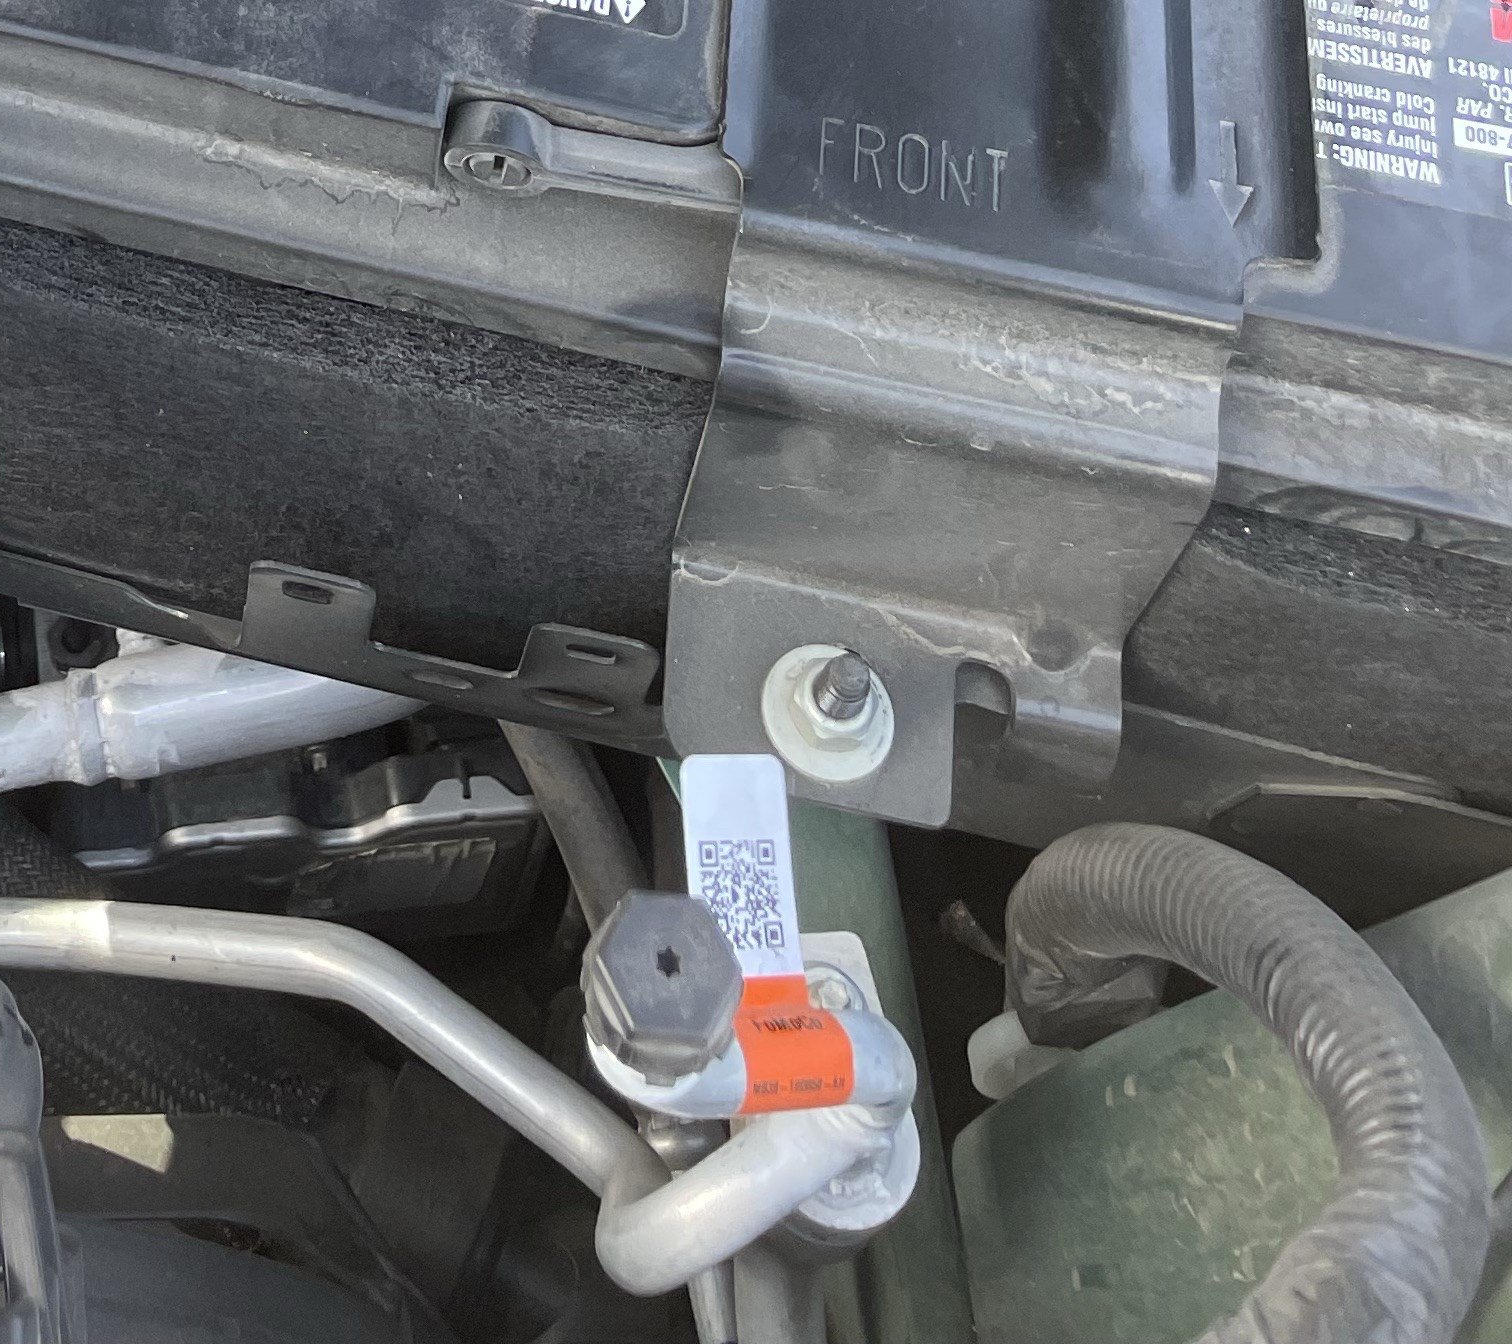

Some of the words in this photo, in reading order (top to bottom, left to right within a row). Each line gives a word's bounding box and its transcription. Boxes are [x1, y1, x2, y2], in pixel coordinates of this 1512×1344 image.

[1400, 33, 1431, 55] des
[1447, 56, 1499, 81] 48121
[1315, 72, 1391, 103] cranking
[1346, 102, 1388, 125] start
[1395, 90, 1435, 115] Cold
[1455, 96, 1493, 119] PAR
[1349, 124, 1383, 145] see
[1391, 108, 1437, 138] jump
[1385, 128, 1438, 159] injury
[811, 111, 1009, 212] FRONT
[1331, 143, 1442, 186] WARNING:
